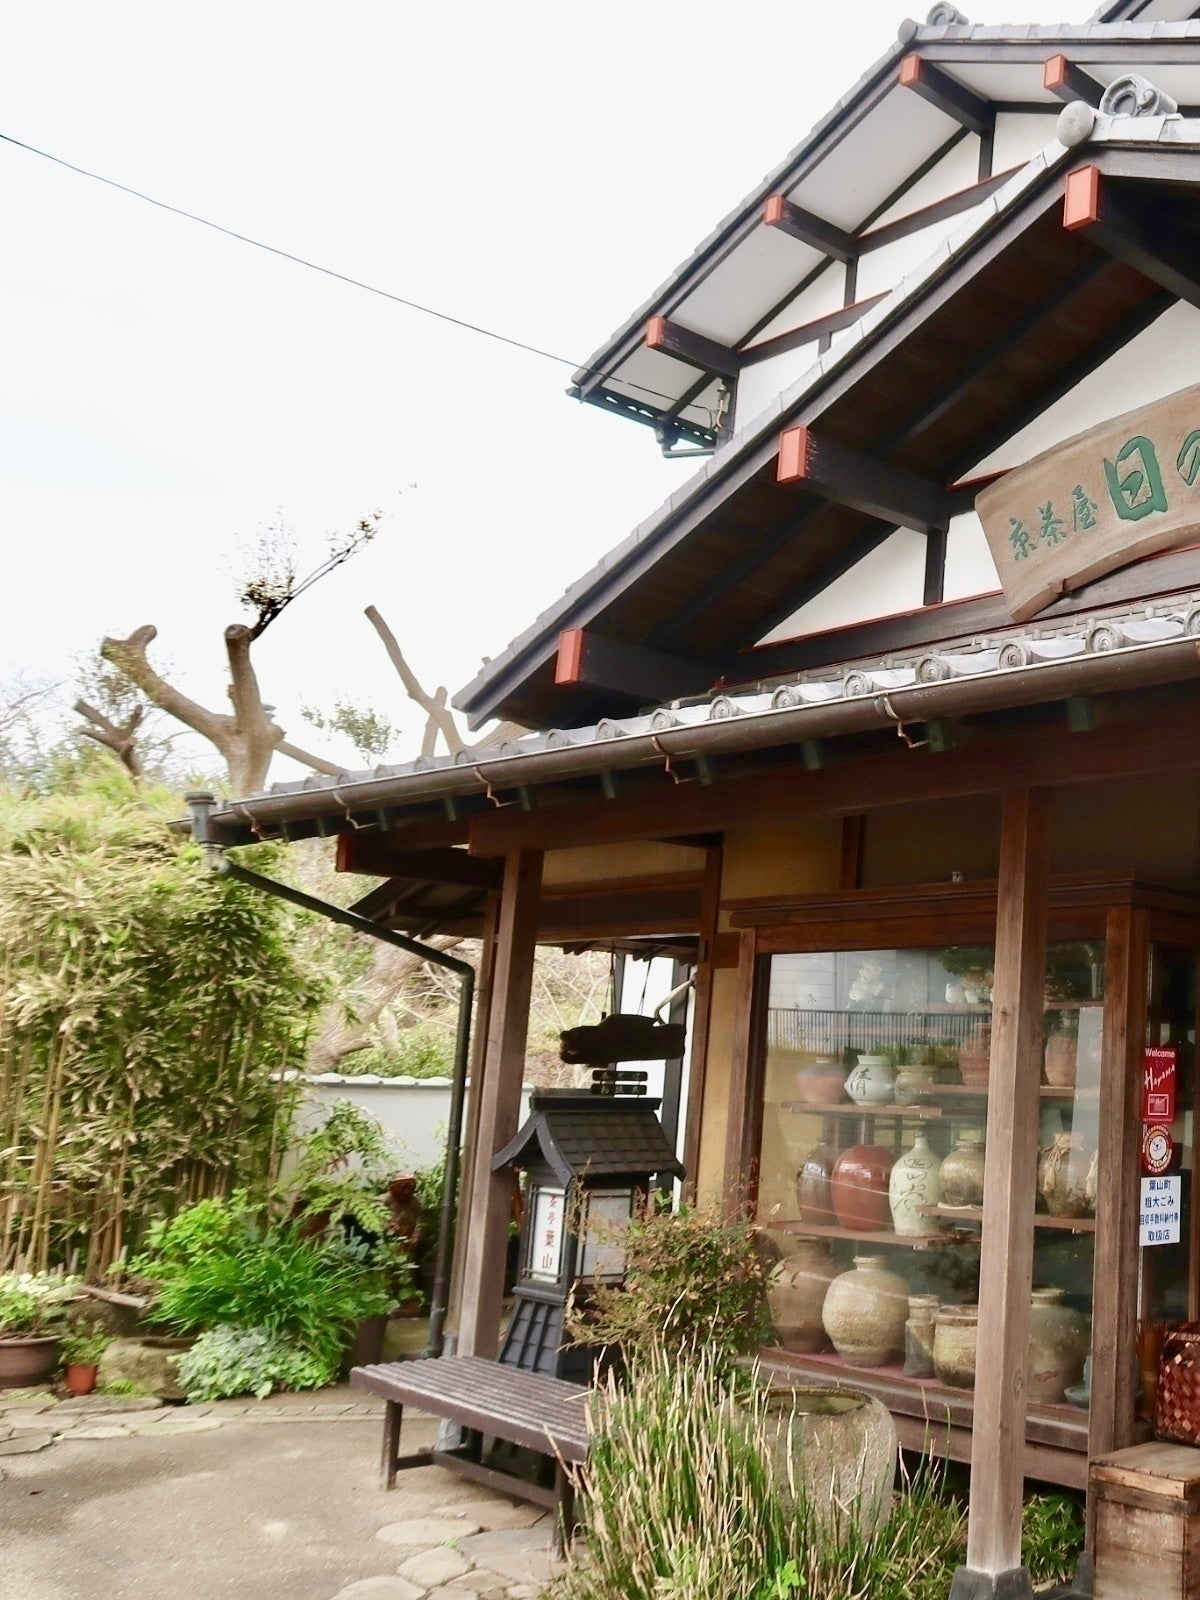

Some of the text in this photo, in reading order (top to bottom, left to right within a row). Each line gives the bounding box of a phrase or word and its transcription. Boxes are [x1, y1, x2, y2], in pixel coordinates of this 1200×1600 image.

[1145, 1047, 1175, 1059] Welcome
[1149, 1179, 1171, 1191] 葉山町
[1145, 1196, 1175, 1208] 粗大ごみ
[1148, 1229, 1171, 1242] 取扱店
